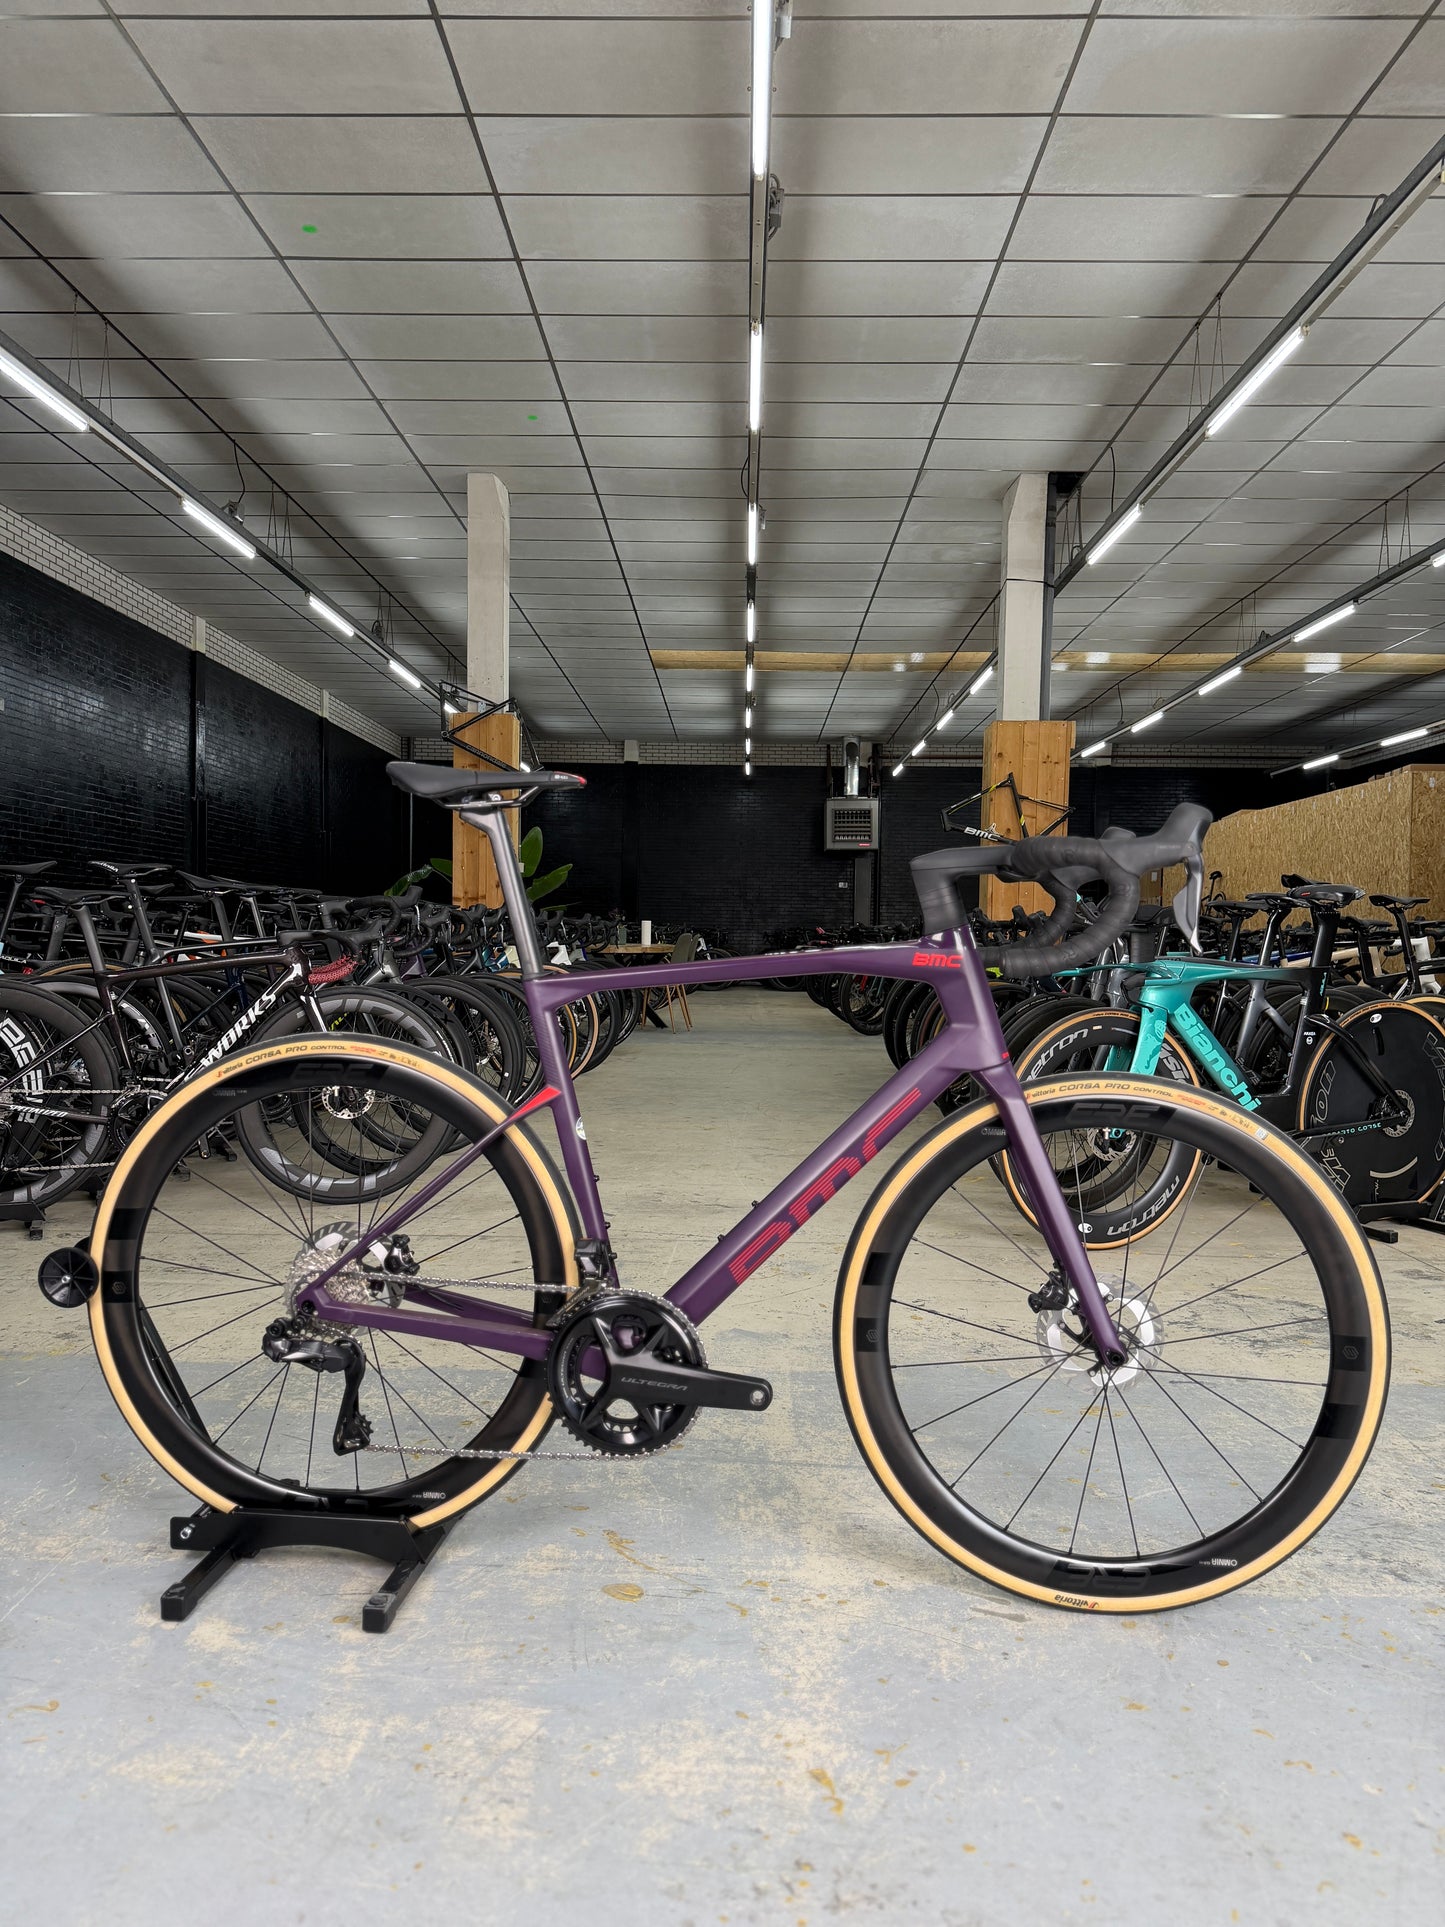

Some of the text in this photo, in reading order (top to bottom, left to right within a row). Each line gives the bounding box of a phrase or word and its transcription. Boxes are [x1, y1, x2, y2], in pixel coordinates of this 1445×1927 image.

[963, 826, 1000, 842] BMC
[911, 952, 963, 968] BMC
[245, 1049, 282, 1064] CORSA
[285, 1045, 308, 1054] PRO
[1173, 1002, 1262, 1112] Bianchi
[1026, 1082, 1174, 1098] vittoria CORSA PRO CONTROL
[9, 1104, 68, 1118] SPECIALIZED
[1106, 1175, 1180, 1236] metron
[620, 1376, 689, 1391] ULTEGRA
[1211, 1557, 1238, 1567] OMNIA
[1054, 1594, 1100, 1610] vittoria
